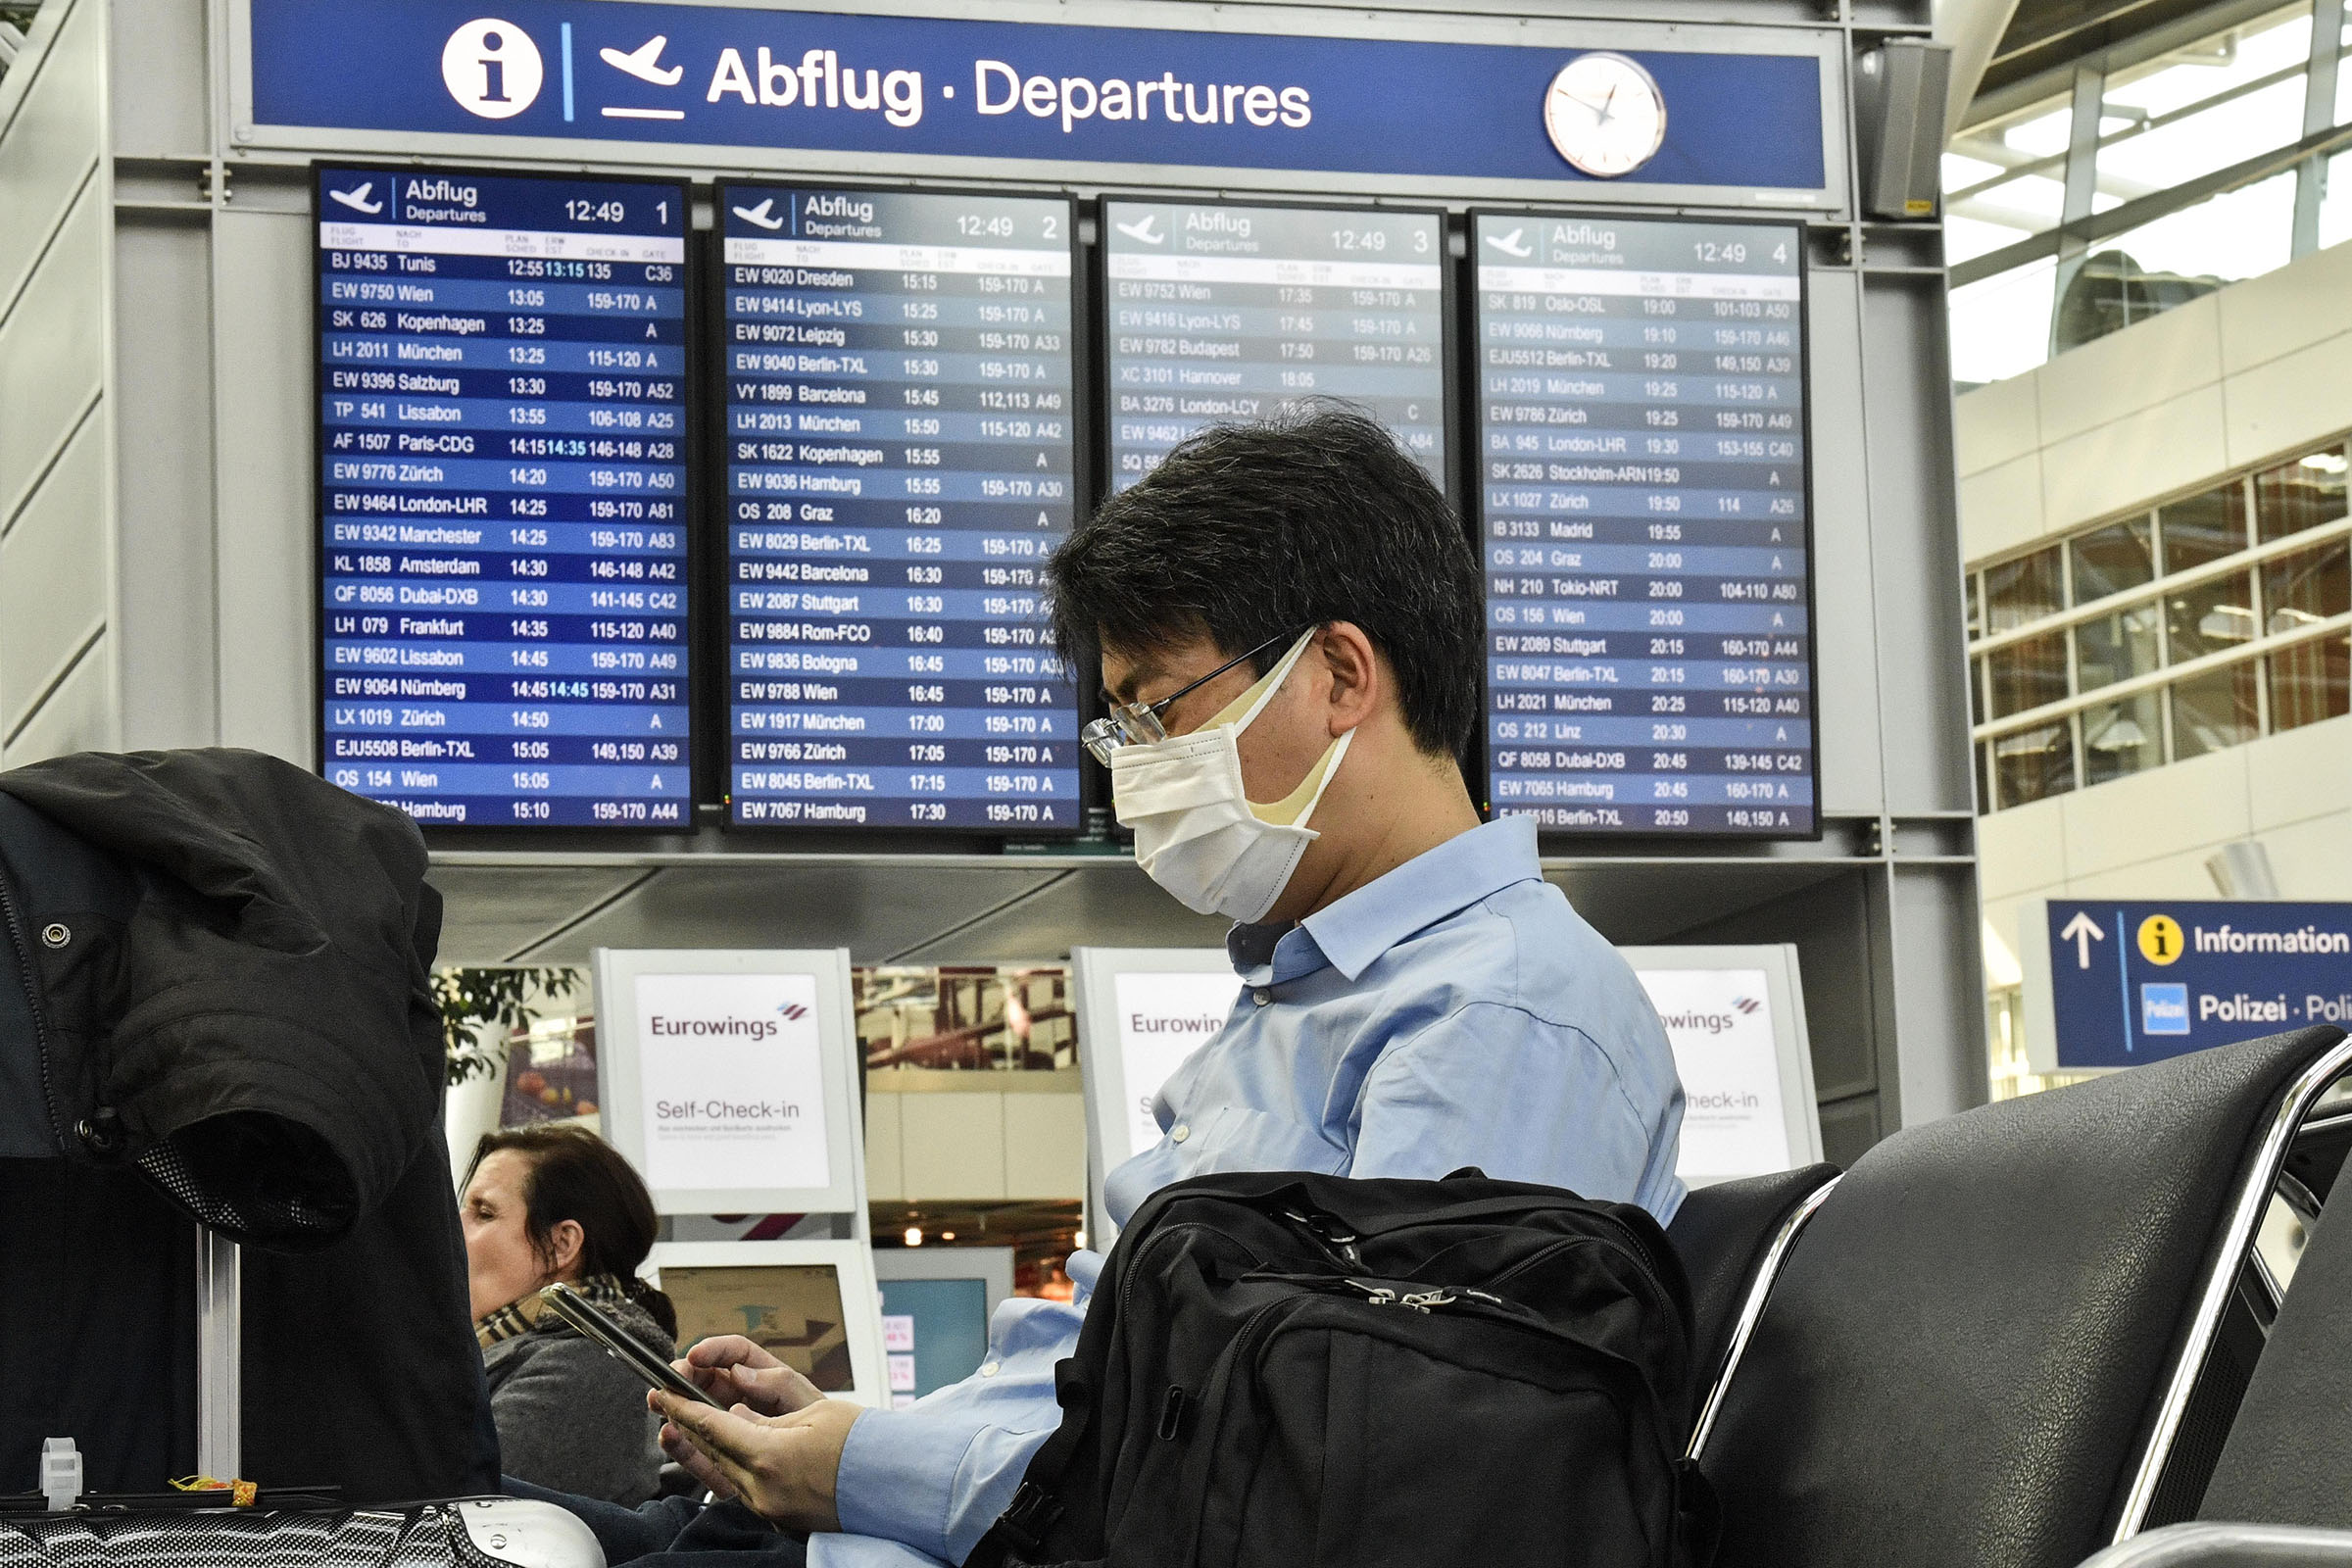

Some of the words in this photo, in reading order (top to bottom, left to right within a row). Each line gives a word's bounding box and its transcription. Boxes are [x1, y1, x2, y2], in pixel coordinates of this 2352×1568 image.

[706, 46, 924, 128] Abflug
[974, 58, 1313, 133] Departures
[405, 179, 478, 208] Abflug
[564, 199, 624, 223] 12:49
[655, 200, 668, 225] 1
[406, 206, 487, 223] Departures
[805, 195, 874, 221] Abflug
[956, 215, 1014, 237] 12:49
[1042, 215, 1058, 239] 2
[805, 220, 883, 238] Departures
[1186, 212, 1251, 237] Abflug
[1331, 230, 1387, 252] 12:49
[1413, 229, 1430, 254] 3
[1186, 235, 1260, 253] Departures
[1552, 225, 1617, 251] Abflug
[1693, 242, 1747, 264] 12:49
[1772, 243, 1788, 265] 4
[399, 254, 435, 272] Tunis
[509, 260, 544, 276] 12:55
[545, 261, 584, 277] 13:15
[1552, 249, 1624, 266] Departures
[798, 270, 853, 286] Dresden
[903, 274, 937, 290] 15:15
[398, 284, 433, 302] Wien
[509, 289, 544, 307] 13:05
[1178, 284, 1210, 299] Wien
[798, 299, 862, 318] Lyon-LYS
[903, 303, 937, 319] 15:25
[1544, 296, 1605, 314] Oslo-OSL
[398, 313, 485, 335] Kopenhagen
[510, 317, 545, 334] 13:25
[1179, 313, 1241, 331] Lyon-LYS
[798, 326, 845, 347] Leipzig
[904, 330, 938, 347] 15:30
[1545, 323, 1603, 344] Nürnberg
[398, 343, 462, 362] München
[510, 347, 545, 365] 13:25
[1179, 338, 1239, 358] Budapest
[799, 355, 867, 374] Berlin-TXL
[904, 359, 938, 376] 15:30
[1546, 350, 1610, 368] Berlin-TXL
[399, 372, 460, 396] Salzburg
[510, 377, 545, 395] 13:30
[1180, 368, 1241, 385] Hannover
[799, 385, 865, 404] Barcelona
[905, 389, 939, 406] 15:45
[1547, 378, 1604, 396] München
[399, 404, 461, 421] Lissabon
[511, 407, 546, 425] 13:55
[1181, 398, 1258, 416] London-LCY
[1547, 407, 1587, 423] Zürich
[800, 415, 860, 432] München
[905, 418, 939, 435] 15:50
[399, 433, 474, 454] Paris-CDG
[511, 438, 546, 456] 14:15
[547, 439, 586, 457] 14:35
[1548, 436, 1626, 453] London-LHR
[800, 445, 883, 466] Kopenhagen
[906, 448, 940, 465] 15:55
[399, 465, 443, 482] Zürich
[511, 467, 546, 485] 14:20
[1549, 464, 1645, 481] Stockholm-ARN
[801, 474, 860, 496] Hamburg
[906, 477, 940, 495] 15:55
[400, 496, 487, 514] London-LHR
[511, 499, 546, 516] 14:25
[1550, 492, 1589, 510] Zürich
[801, 504, 833, 521] Graz
[906, 507, 941, 524] 16:20
[400, 525, 481, 545] Manchester
[512, 528, 547, 546] 14:25
[1550, 521, 1592, 538] Madrid
[802, 533, 870, 553] Berlin-TXL
[906, 536, 941, 554] 16:25
[400, 557, 479, 574] Amsterdam
[512, 559, 547, 576] 14:30
[1551, 550, 1581, 567] Graz
[1648, 552, 1682, 568] 20:00
[802, 564, 868, 582] Barcelona
[907, 566, 942, 584] 16:30
[401, 586, 478, 606] Dubai-DXB
[512, 589, 547, 607] 14:30
[1552, 578, 1618, 596] Tokio-NRT
[1649, 581, 1683, 598] 20:00
[803, 593, 858, 614] Stuttgart
[907, 596, 942, 613] 16:30
[401, 617, 464, 636] Frankfurt
[513, 619, 548, 637] 14:35
[1553, 608, 1585, 624] Wien
[1649, 609, 1683, 626] 20:00
[803, 623, 870, 642] Rom-FCO
[908, 625, 943, 643] 16:40
[1553, 636, 1606, 657] Stuttgart
[1650, 638, 1684, 655] 20:15
[401, 649, 464, 666] Lissabon
[513, 650, 548, 667] 14:45
[803, 653, 858, 674] Bologna
[908, 655, 943, 672] 16:45
[1554, 665, 1618, 683] Berlin-TXL
[1651, 666, 1685, 683] 20:15
[401, 678, 466, 700] Nürnberg
[513, 681, 548, 698] 14:45
[550, 682, 589, 699] 14:45
[804, 683, 837, 701] Wien
[909, 685, 944, 703] 16:45
[1554, 694, 1611, 711] München
[1651, 695, 1685, 712] 20:25
[401, 709, 445, 727] Zürich
[514, 710, 549, 728] 14:50
[804, 713, 864, 731] München
[909, 714, 944, 732] 17:00
[1555, 723, 1581, 740] Linz
[1652, 723, 1686, 741] 20:30
[401, 739, 474, 758] Berlin-TXL
[514, 741, 549, 759] 15:05
[804, 743, 846, 760] Zürich
[910, 744, 945, 761] 17:05
[1556, 751, 1625, 769] Dubai-DXB
[1653, 753, 1687, 769] 20:45
[402, 770, 437, 788] Wien
[514, 771, 549, 789] 15:05
[805, 772, 873, 791] Berlin-TXL
[910, 774, 945, 792] 17:15
[1557, 781, 1613, 801] Hamburg
[1653, 781, 1687, 798] 20:45
[402, 801, 466, 822] Hamburg
[514, 802, 550, 819] 15:10
[805, 803, 865, 823] Hamburg
[910, 803, 945, 820] 17:30
[1557, 808, 1622, 826] Berlin-TXL
[1654, 809, 1688, 826] 20:50
[2193, 924, 2350, 954] Information
[2199, 993, 2288, 1022] Polizei
[651, 1015, 778, 1042] Eurowings
[1131, 1012, 1223, 1034] Eurowin
[1661, 1008, 1734, 1035] wings
[656, 1100, 801, 1120] Self-Check-in
[1687, 1091, 1759, 1109] heck-in
